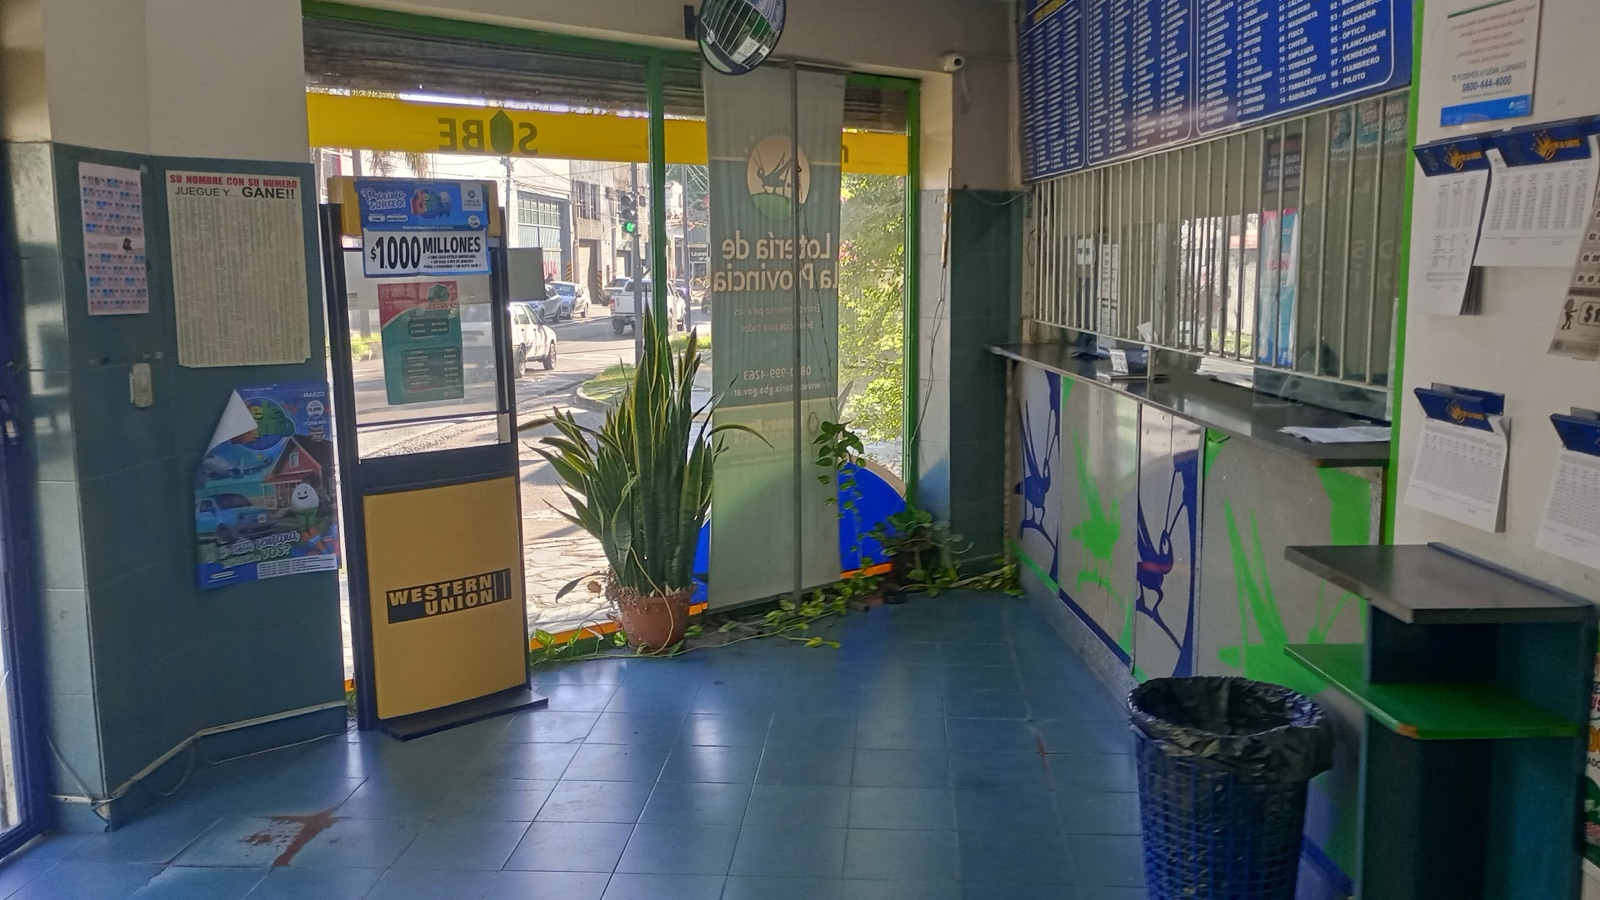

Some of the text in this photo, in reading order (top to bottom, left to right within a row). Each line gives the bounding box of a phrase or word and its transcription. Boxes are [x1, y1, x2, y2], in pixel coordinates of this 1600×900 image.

[1342, 9, 1376, 28] SOLDADOR
[1342, 25, 1366, 39] ÓPTICO
[1342, 29, 1386, 51] PLANCHADOR
[1288, 37, 1307, 49] CHOFER
[1288, 44, 1314, 60] EMPLEADO
[1343, 44, 1377, 62] VENDEDOR
[1288, 54, 1318, 70] VERDULERO
[1343, 56, 1380, 74] FIAMBRERO
[1343, 72, 1366, 85] PILOTO
[1462, 75, 1512, 92] 0800-444-4000
[170, 175, 297, 188] SU NOMBRE CON SU NUMERO
[175, 187, 220, 196] JUEGUE
[241, 186, 295, 199] GANE!!
[422, 236, 481, 254] MILLONES
[389, 574, 492, 606] WESTERN
[425, 590, 493, 615] UNION
